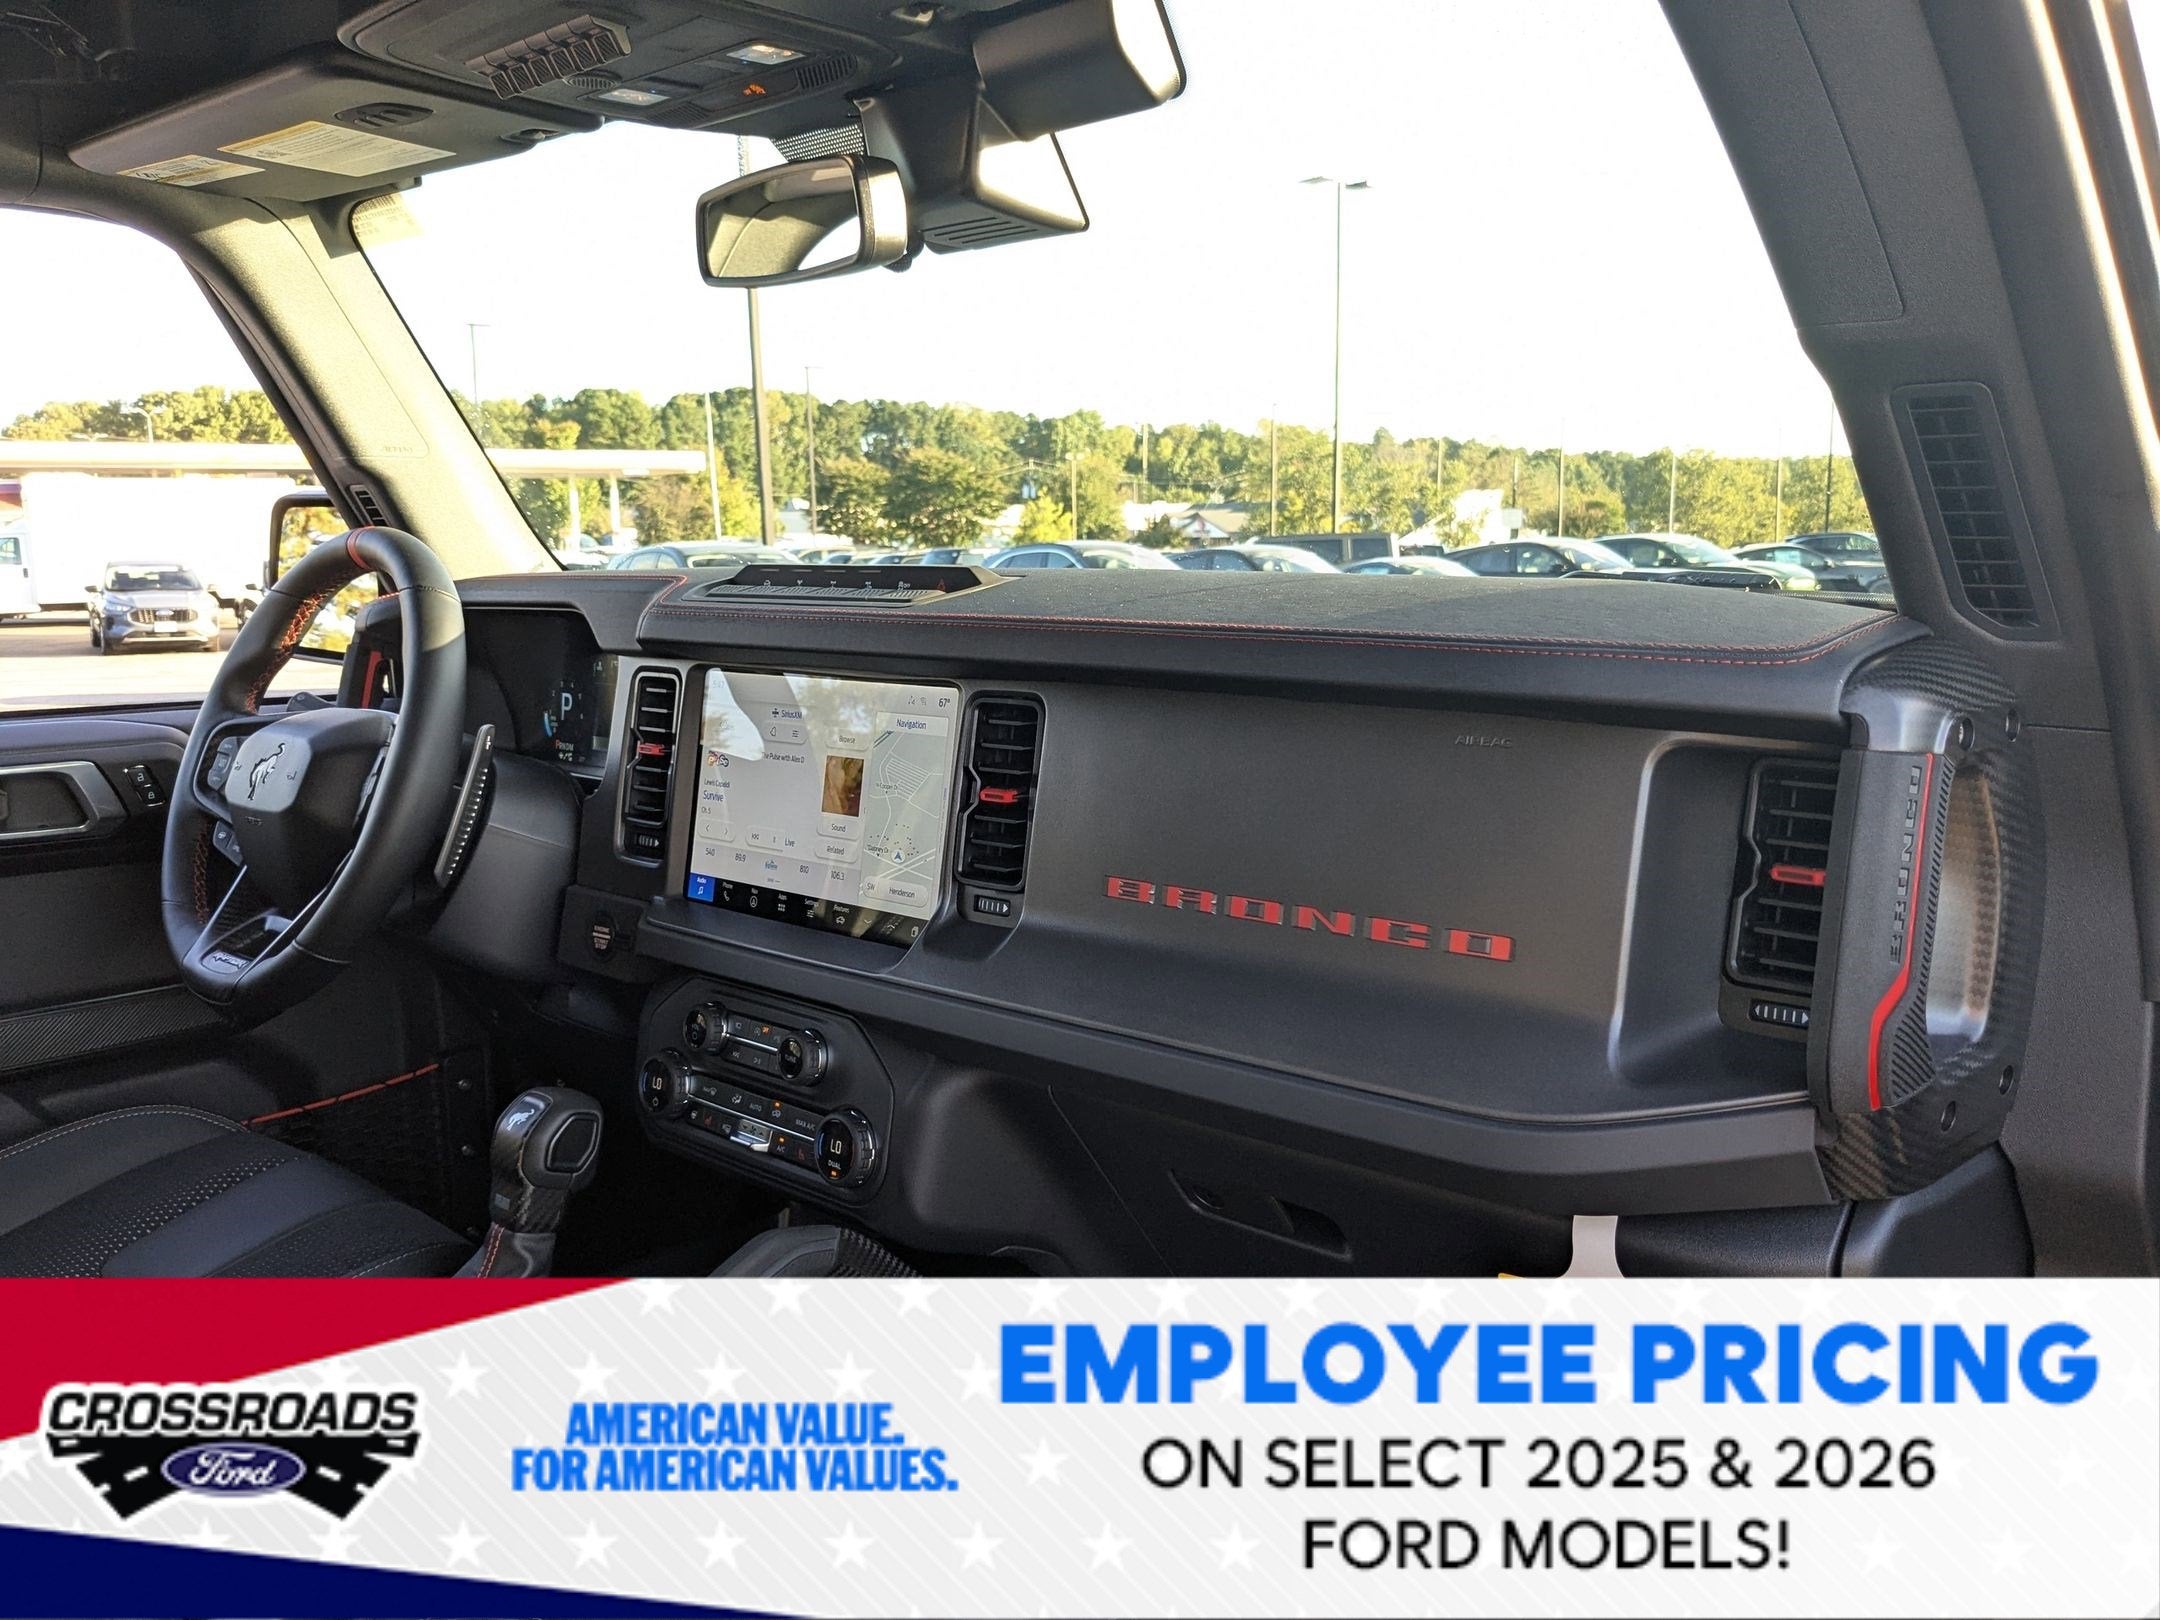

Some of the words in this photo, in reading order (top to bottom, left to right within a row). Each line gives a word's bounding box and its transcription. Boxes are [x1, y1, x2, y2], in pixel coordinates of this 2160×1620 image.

[561, 692, 573, 721] P
[781, 709, 803, 720] SiriusXM
[896, 718, 927, 730] Navigation
[703, 789, 724, 802] Survive
[831, 823, 846, 833] Sound
[784, 838, 795, 847] Live
[826, 845, 845, 856] Related
[1889, 765, 1922, 965] BRONCO
[889, 887, 916, 899] Henderson
[1105, 875, 1515, 961] BRONCO
[830, 1138, 842, 1155] LO
